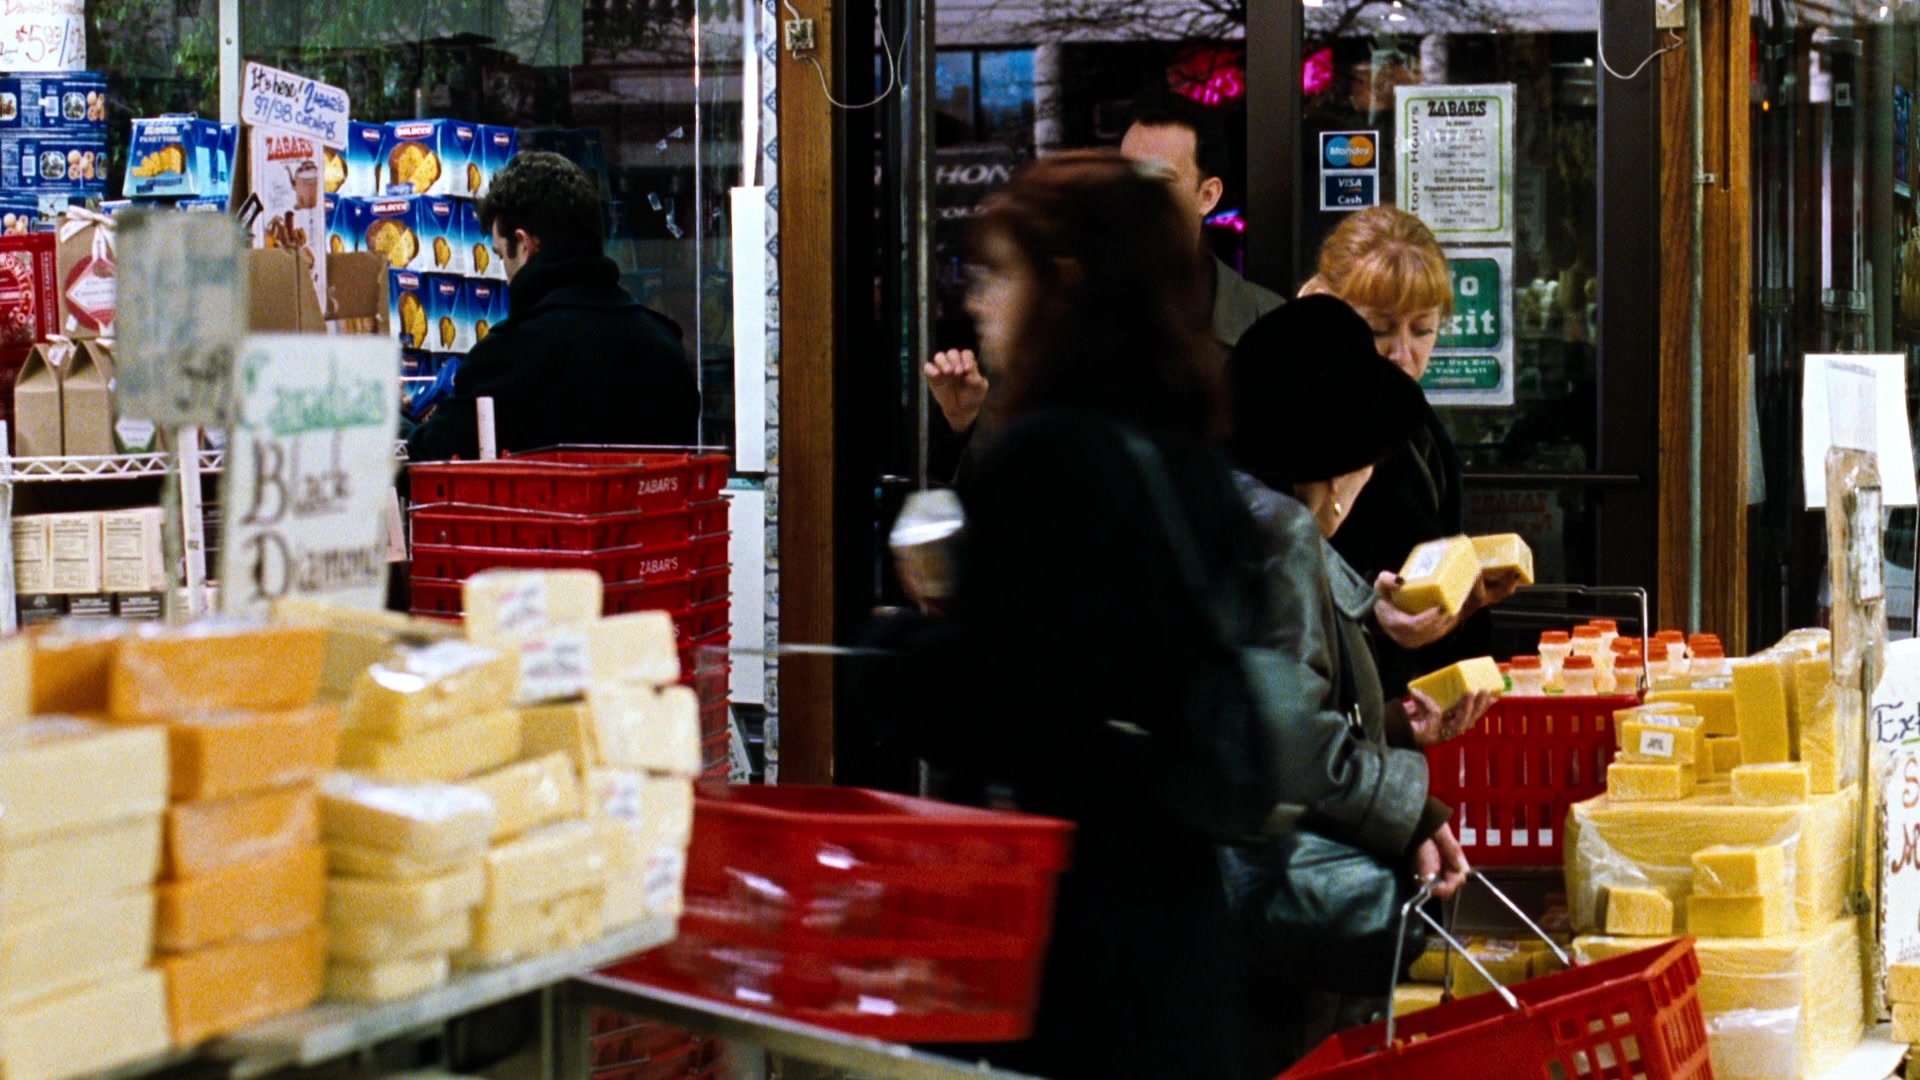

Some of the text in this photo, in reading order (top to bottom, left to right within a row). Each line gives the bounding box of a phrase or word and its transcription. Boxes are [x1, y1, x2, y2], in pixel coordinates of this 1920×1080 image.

[1338, 178, 1362, 187] VISA
[1338, 195, 1362, 205] Cash
[1439, 309, 1496, 335] xit
[240, 428, 352, 526] Black
[637, 477, 679, 496] ZABAR'S
[639, 557, 679, 576] ZABAR'S
